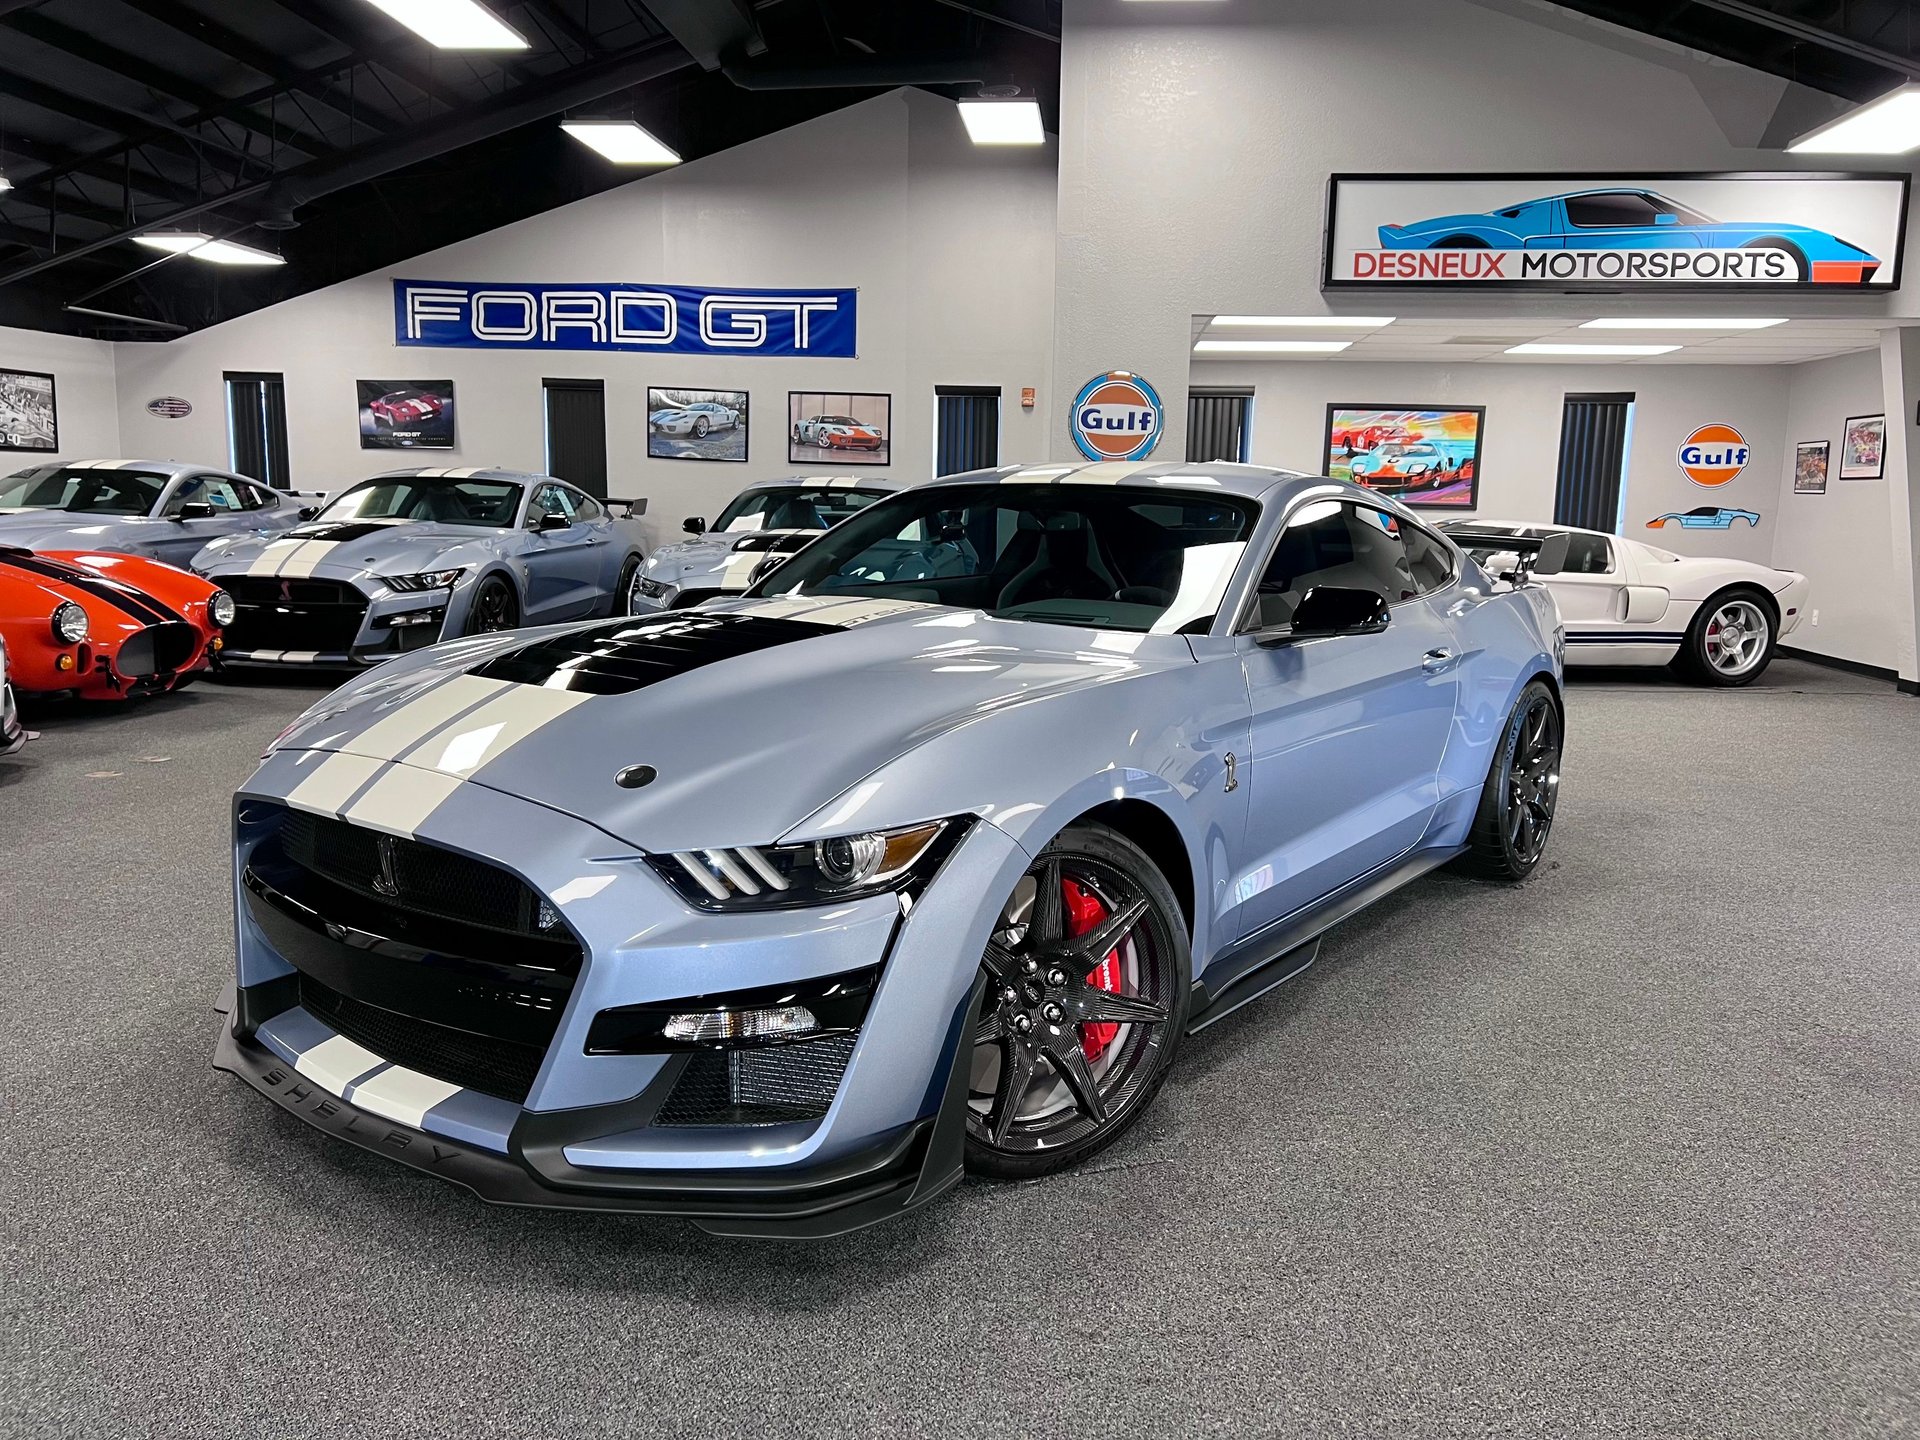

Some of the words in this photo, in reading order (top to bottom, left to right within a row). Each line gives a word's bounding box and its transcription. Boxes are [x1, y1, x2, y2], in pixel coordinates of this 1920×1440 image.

[1353, 252, 1507, 279] DESNEUX
[1521, 252, 1786, 279] MOTORSPORTS
[406, 287, 678, 345] FORD
[700, 295, 838, 349] GT
[1081, 408, 1152, 431] Gulf
[1681, 446, 1748, 465] Gulf
[261, 1067, 463, 1164] SHELBY
